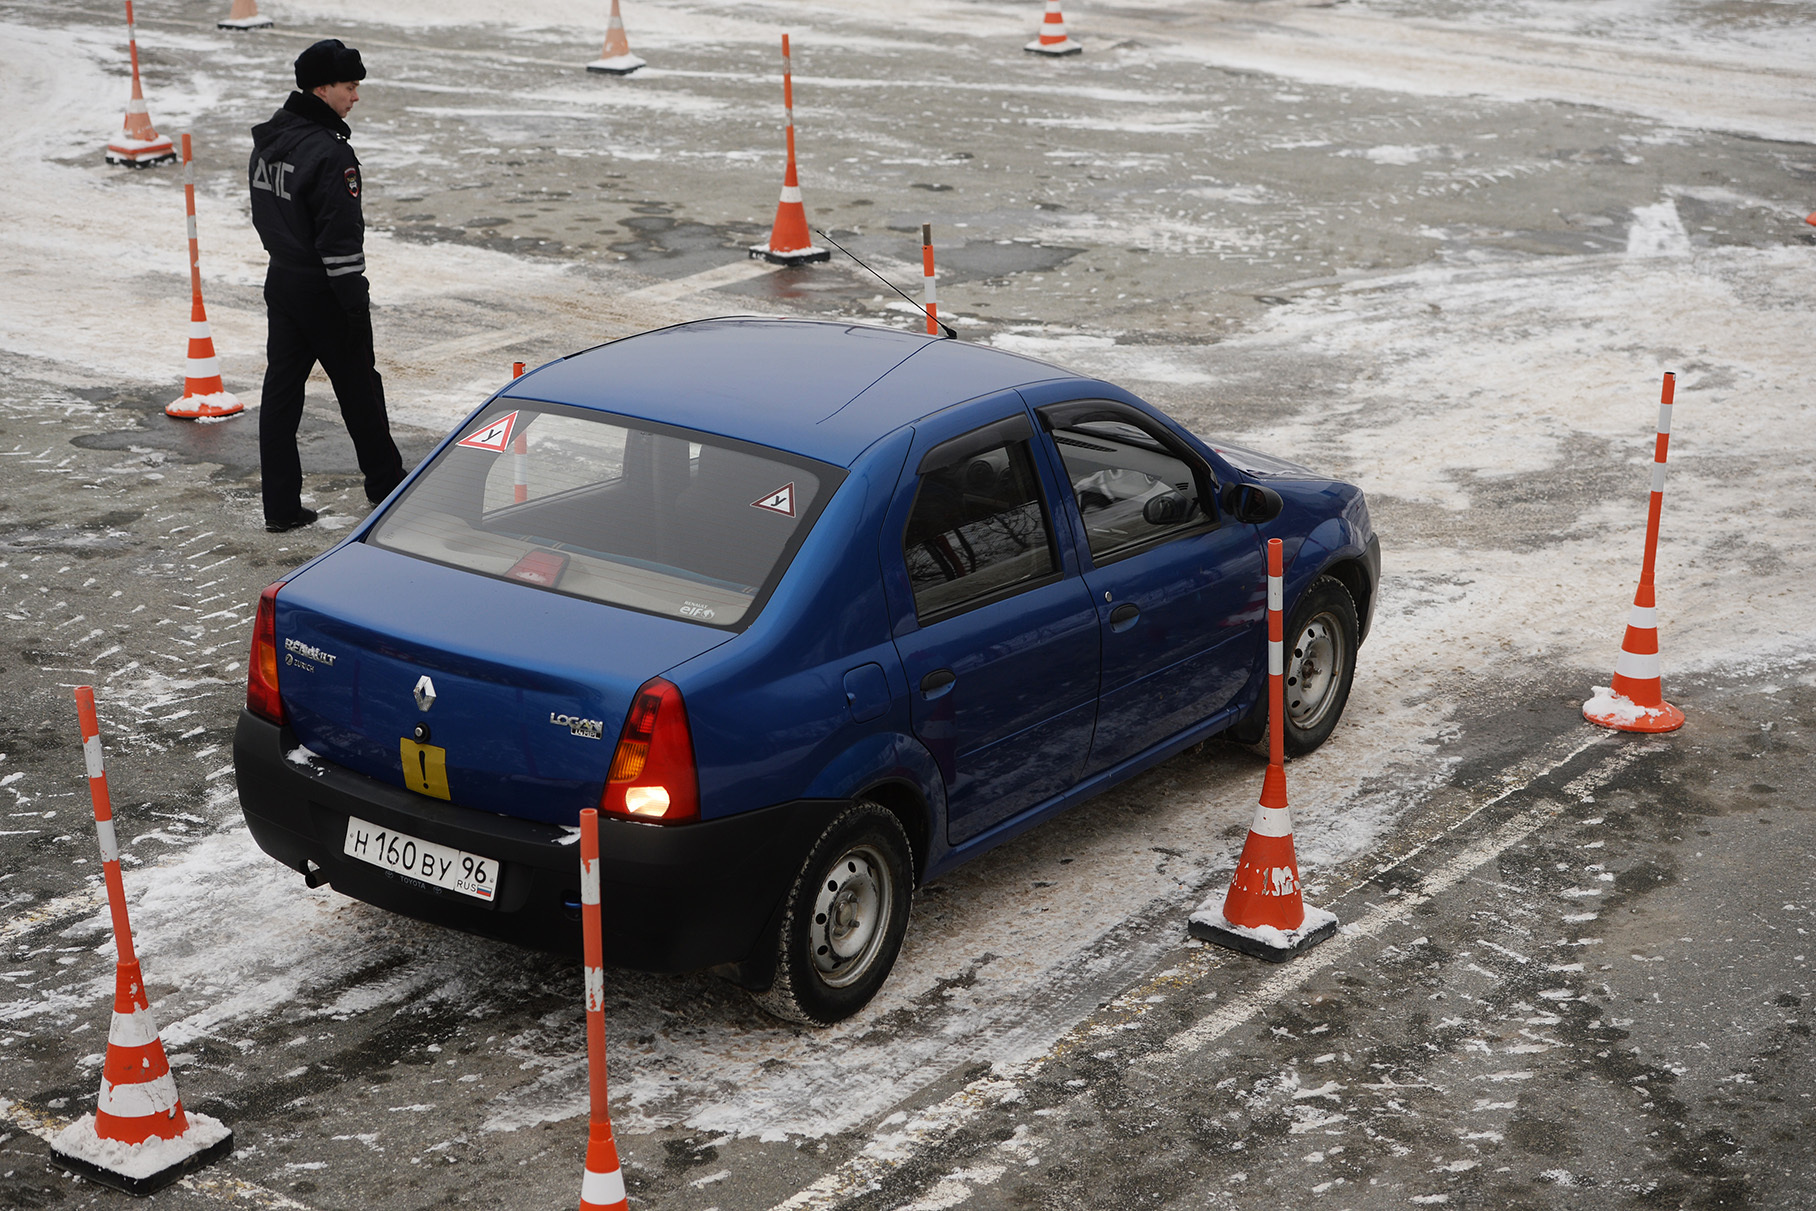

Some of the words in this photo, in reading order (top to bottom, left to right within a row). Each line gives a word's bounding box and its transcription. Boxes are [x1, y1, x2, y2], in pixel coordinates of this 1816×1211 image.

[252, 156, 295, 201] ДПС
[550, 712, 603, 732] LOGAN
[399, 875, 427, 890] TOYOTA
[456, 879, 477, 893] RUS
